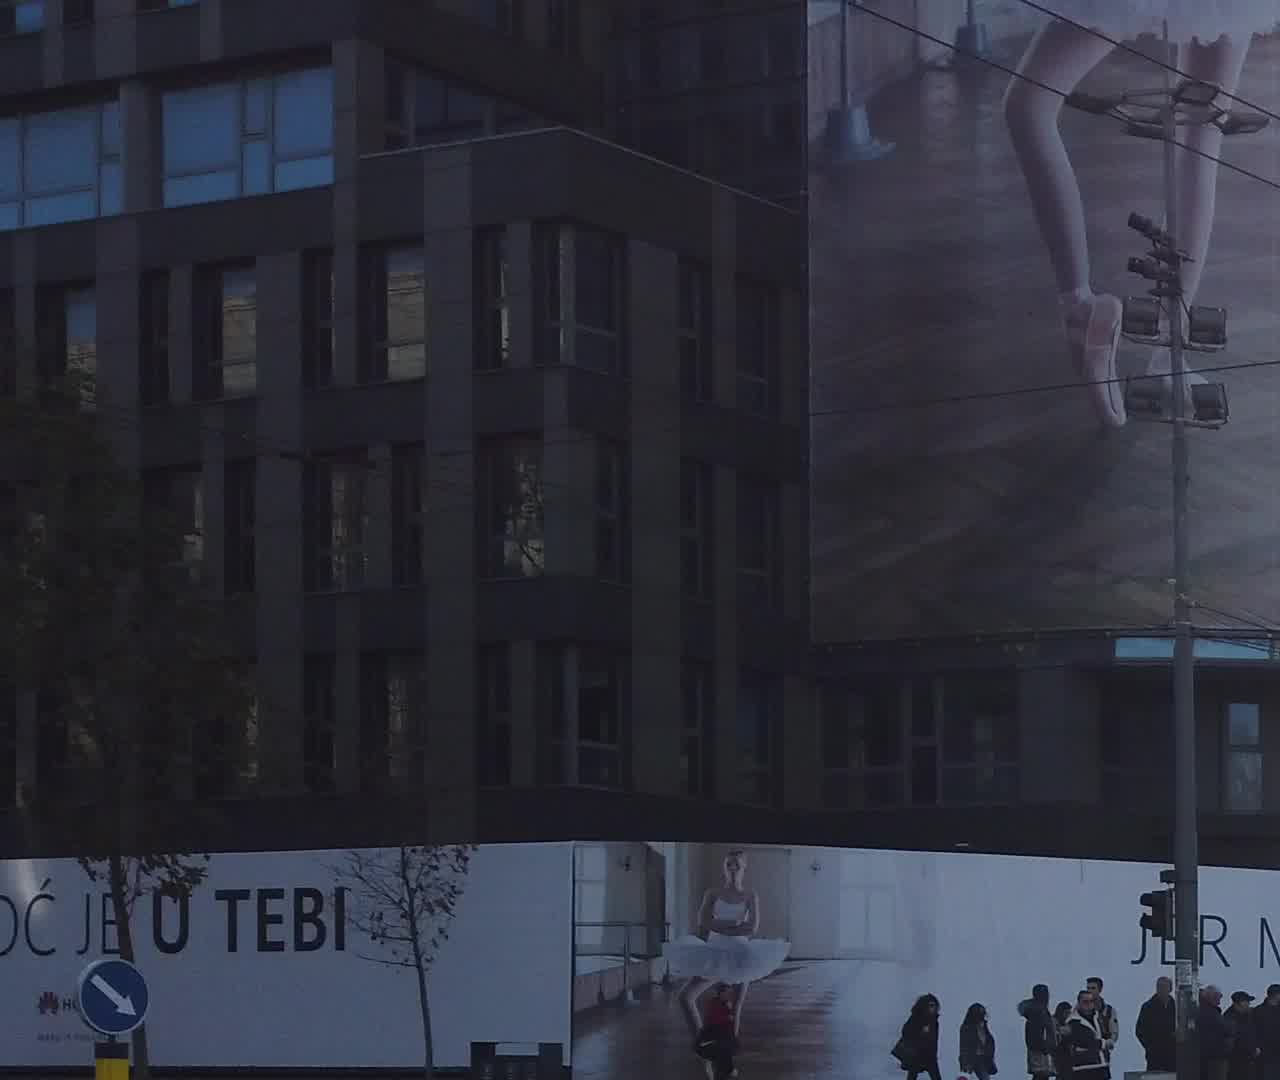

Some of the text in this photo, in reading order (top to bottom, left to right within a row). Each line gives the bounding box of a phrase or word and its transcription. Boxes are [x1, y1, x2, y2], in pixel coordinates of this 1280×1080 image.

[76, 892, 122, 955] JE
[152, 885, 190, 954] U
[215, 887, 346, 952] TEBI
[1131, 914, 1230, 968] JR
